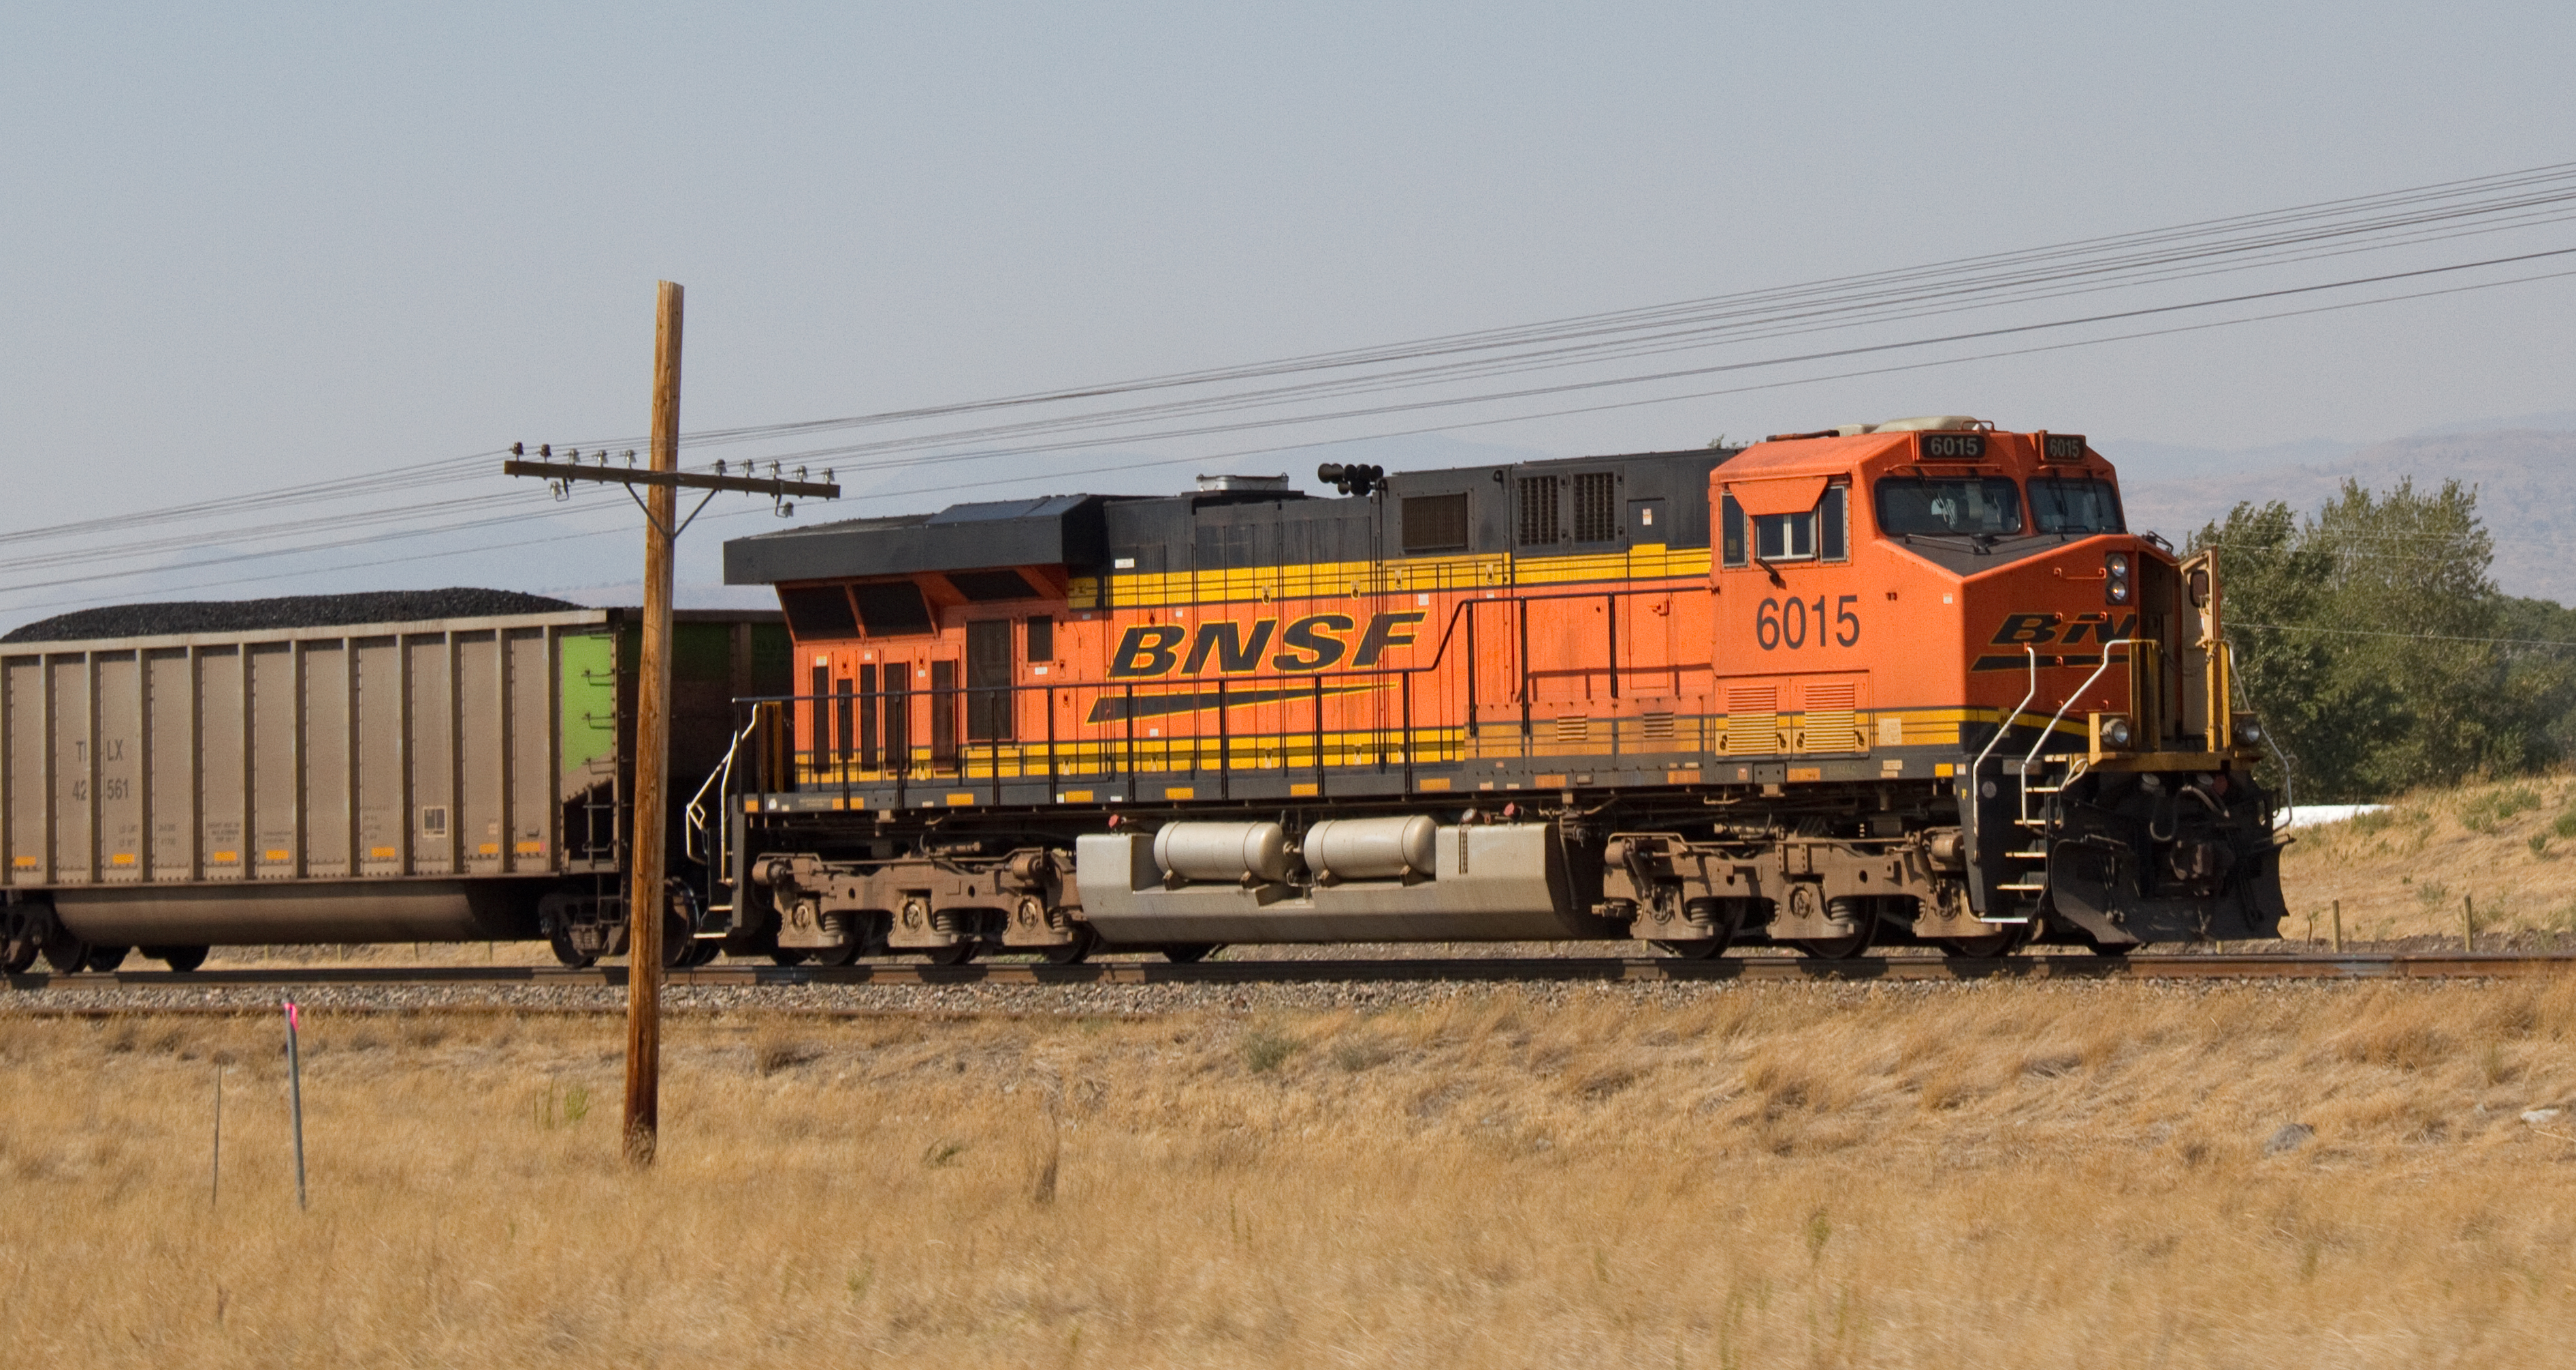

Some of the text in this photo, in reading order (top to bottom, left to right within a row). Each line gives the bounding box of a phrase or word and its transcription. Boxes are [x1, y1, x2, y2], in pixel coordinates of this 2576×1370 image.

[1930, 437, 1978, 456] 6015
[2049, 439, 2080, 458] 6015
[1757, 595, 1860, 650] 6015
[1106, 610, 1428, 680] BNSF
